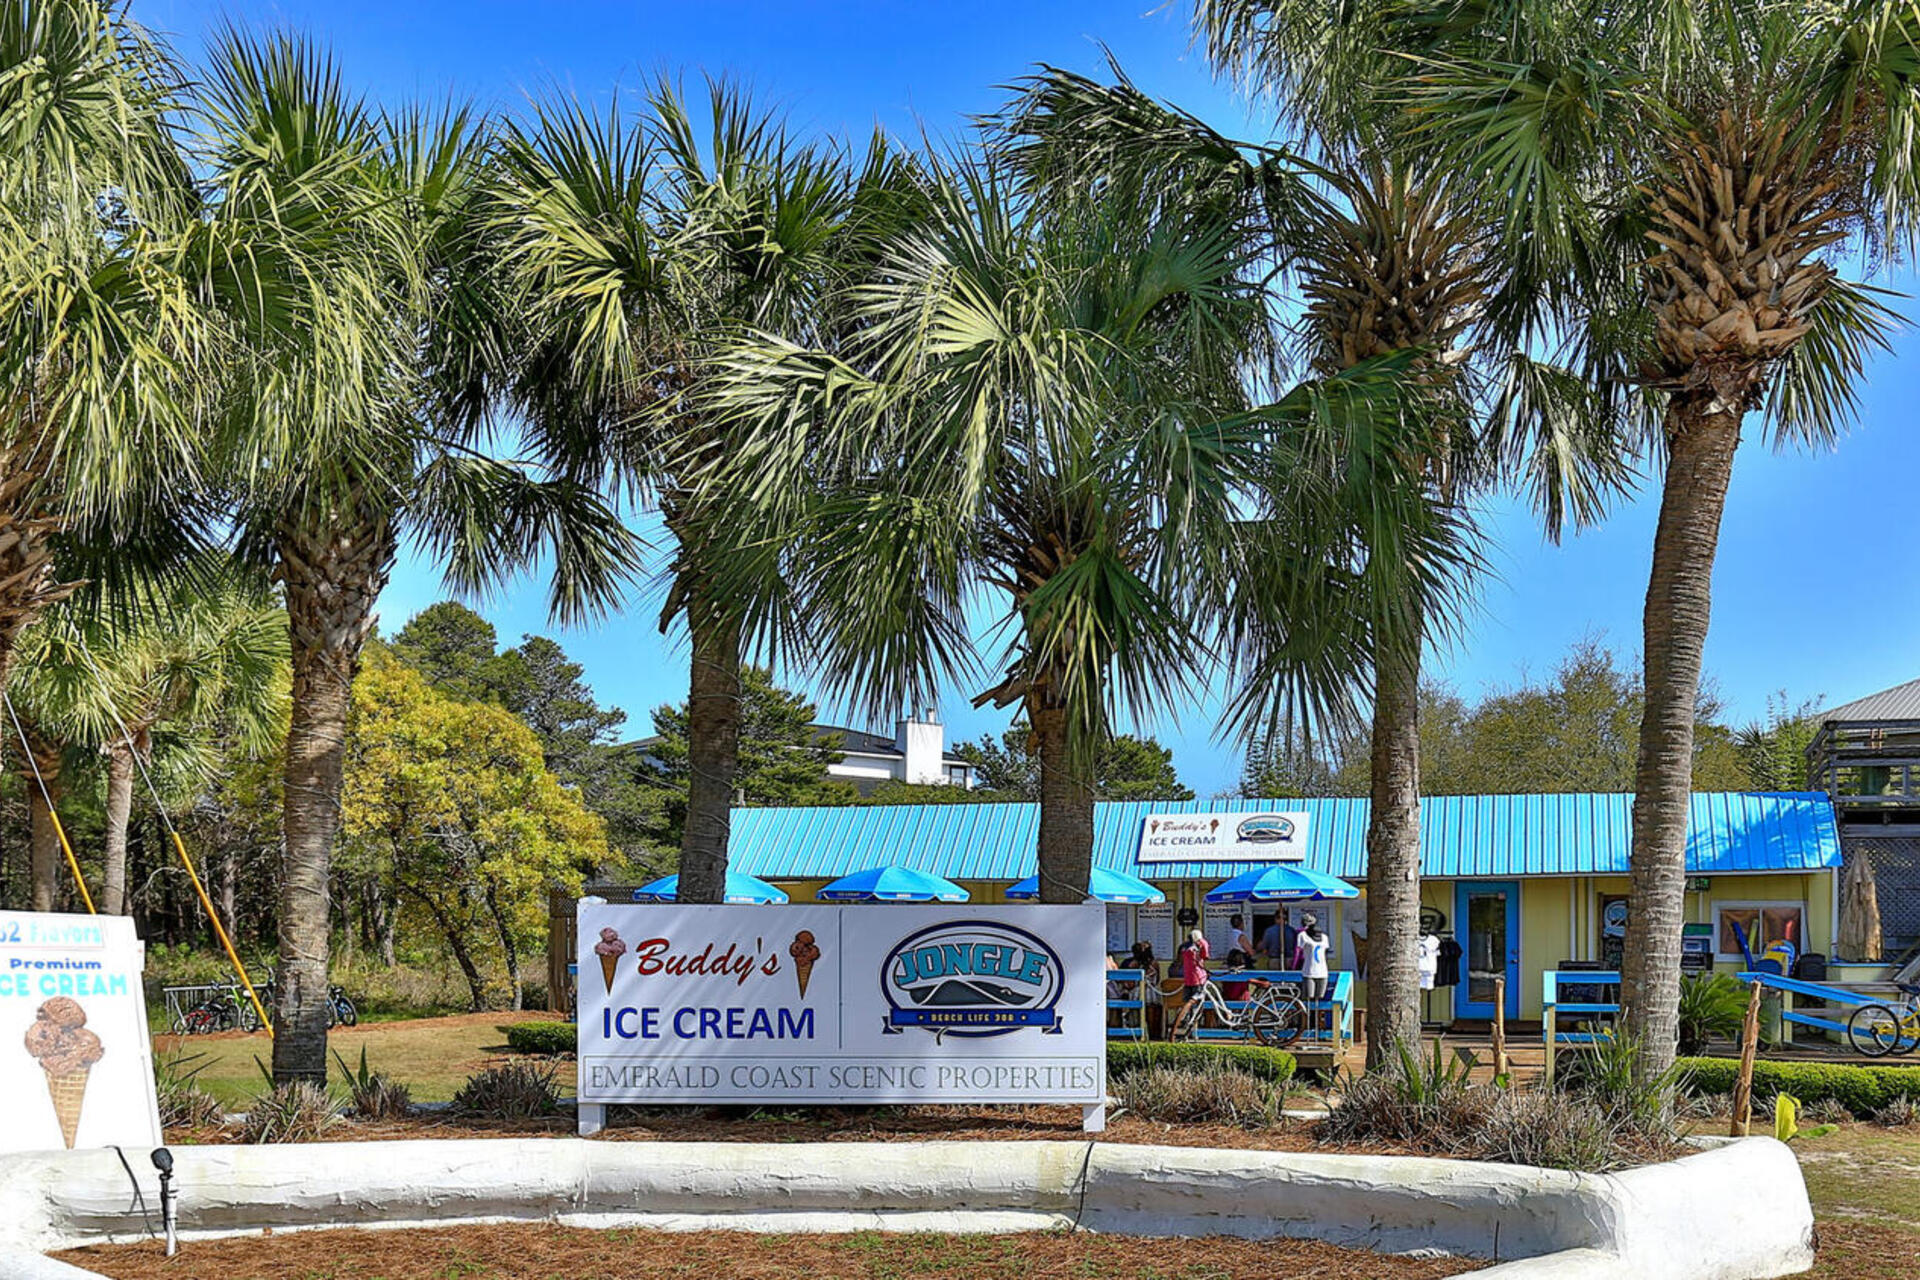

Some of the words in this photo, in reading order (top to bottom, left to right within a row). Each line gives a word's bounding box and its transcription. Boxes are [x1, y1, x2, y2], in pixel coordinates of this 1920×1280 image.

[1162, 820, 1207, 832] Buddy's
[1149, 837, 1167, 846] ICE
[1170, 836, 1216, 846] CREAM
[30, 921, 102, 943] Flavors
[10, 958, 102, 969] Premium
[636, 937, 781, 986] Buddy's
[896, 943, 1049, 986] JONGLE
[38, 973, 127, 996] CREAM
[603, 1007, 660, 1039] ICE
[673, 1007, 814, 1039] CREAM
[931, 1014, 963, 1022] BEACH
[967, 1014, 989, 1022] LIFE
[592, 1065, 720, 1089] EMERALD
[730, 1065, 821, 1089] COAST
[828, 1065, 927, 1089] SCENIC
[937, 1065, 1095, 1089] PROPERTIES
